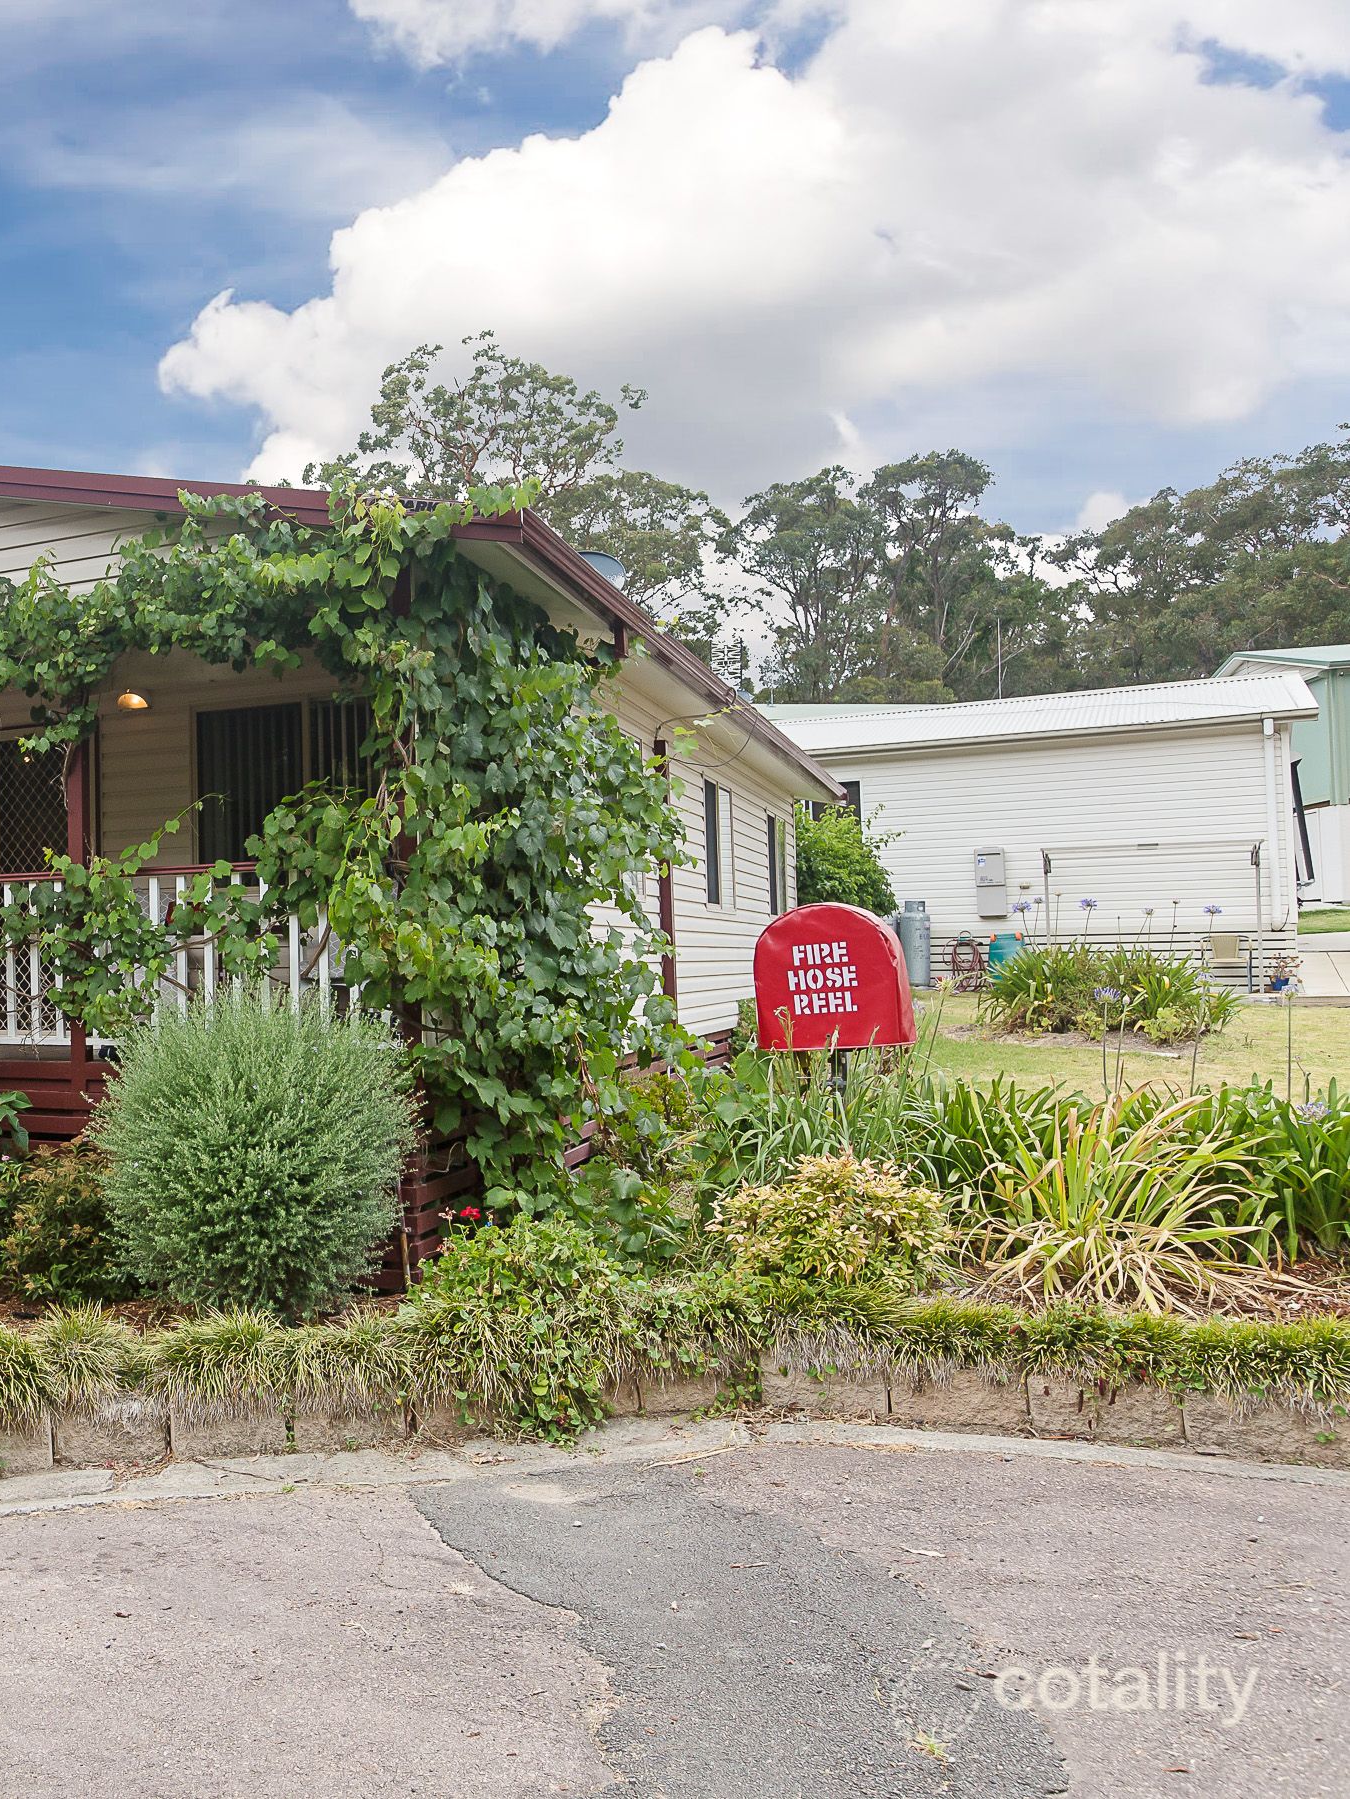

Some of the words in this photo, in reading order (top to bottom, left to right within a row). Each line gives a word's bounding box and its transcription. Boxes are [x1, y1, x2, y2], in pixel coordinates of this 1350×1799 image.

[792, 941, 848, 966] FIRE
[787, 966, 858, 991] HOSE
[793, 991, 858, 1015] REEL
